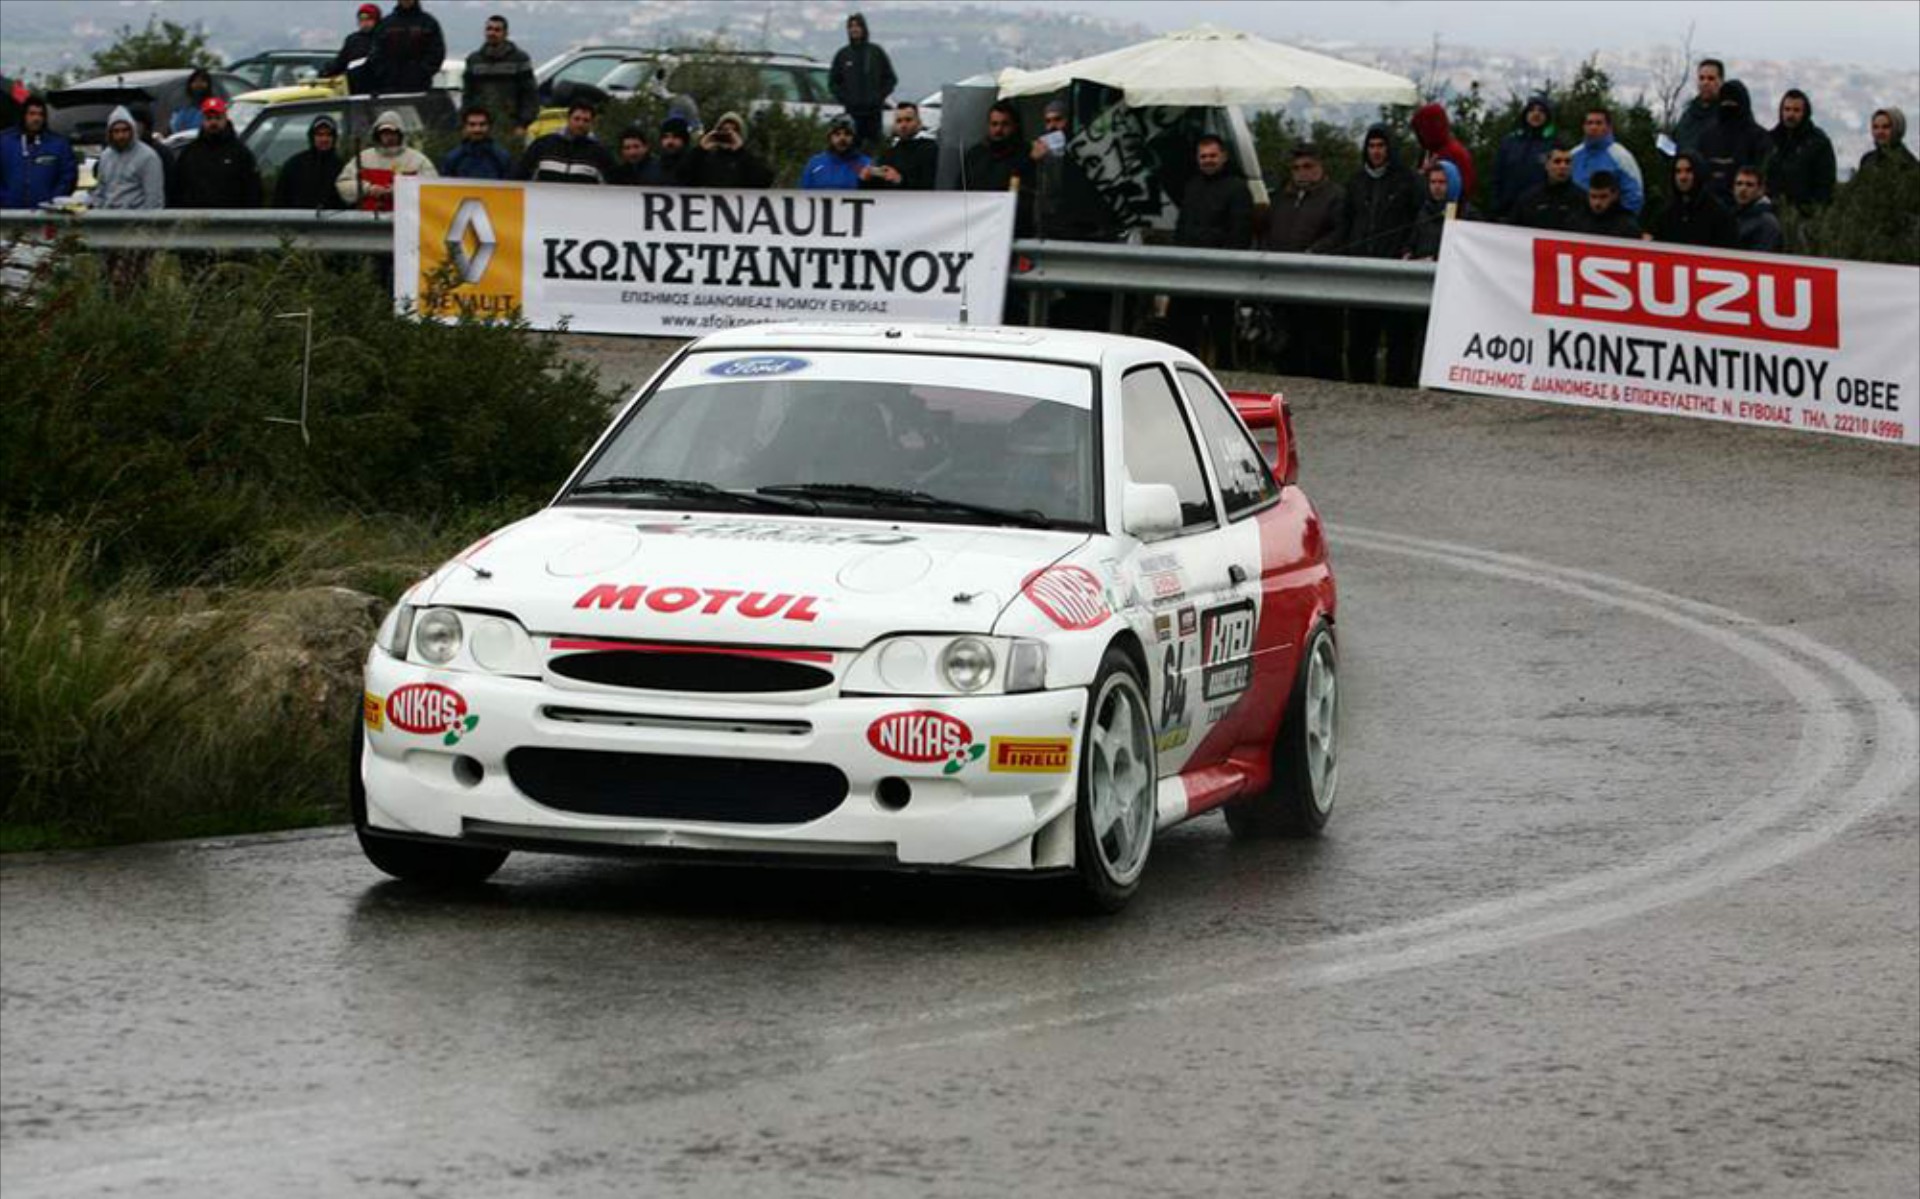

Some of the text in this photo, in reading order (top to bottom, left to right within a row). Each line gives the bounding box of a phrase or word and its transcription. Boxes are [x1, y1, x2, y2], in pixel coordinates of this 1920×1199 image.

[642, 193, 875, 238] RENAULT
[543, 239, 974, 294] ΚΩΝΣΤΑΝΤΙΝΟΥ
[621, 291, 888, 313] ΕΠΙΣΗΜΟΣ ΔΙΑΝΟΜΕΑΣ ΝΟΜΟΥ ΕΥΒΟΙΑΣ
[1556, 253, 1812, 332] ISUZU
[723, 359, 792, 376] Ford
[1462, 329, 1900, 412] ΑΦΟΙ ΚΩΝΣΤΑΝΤΙΝΟΥ ΟΒΕΕ
[1449, 366, 1526, 391] ΕΠΙΣΗΜΟΣ
[1531, 377, 1607, 400] ΔΙΑΝΟΜΕΑΣ
[1613, 386, 1621, 401] &
[1739, 401, 1792, 425] ΕΥΒΟΙΑΣ
[1834, 414, 1869, 434] 22210
[573, 583, 820, 622] MOTUL
[393, 687, 457, 729] NIKAS
[879, 716, 960, 757] NIKAS
[997, 742, 1068, 767] PIRELLI
